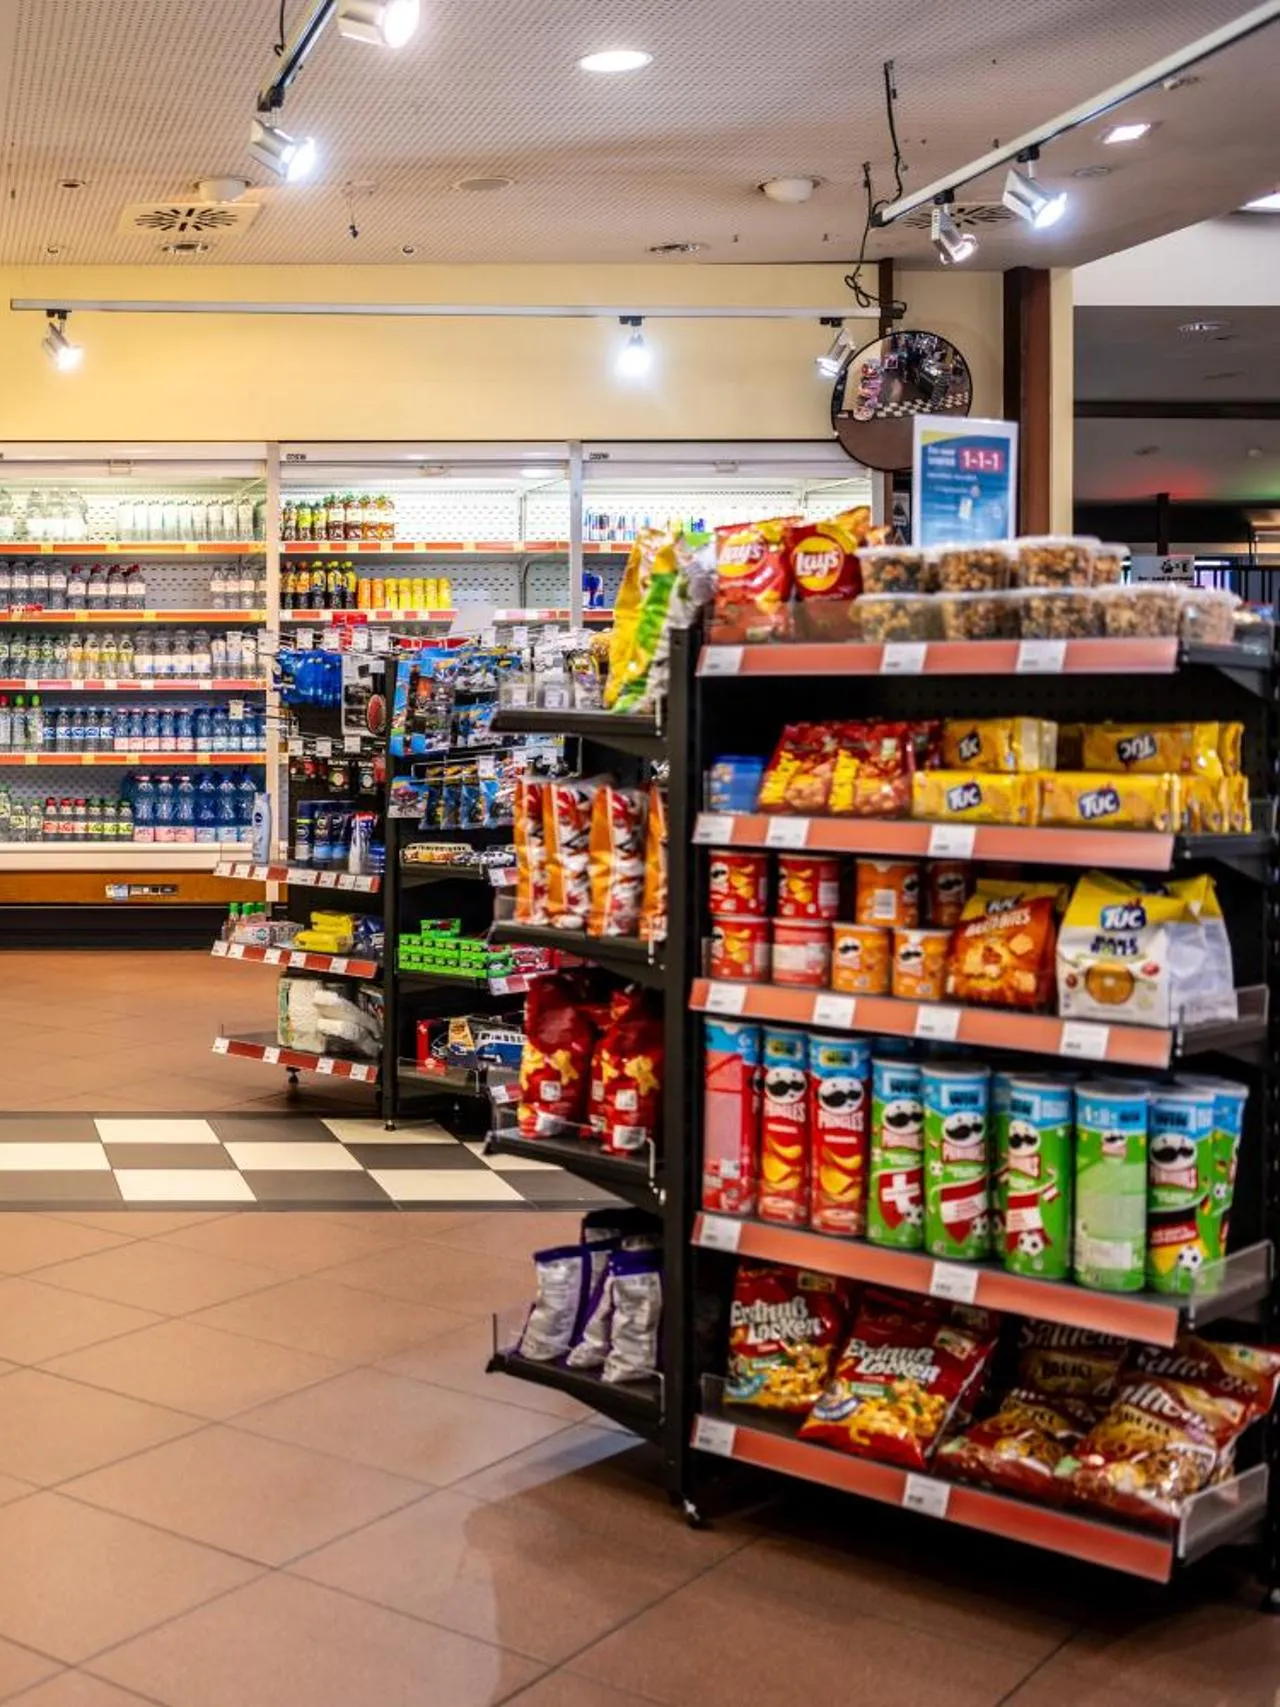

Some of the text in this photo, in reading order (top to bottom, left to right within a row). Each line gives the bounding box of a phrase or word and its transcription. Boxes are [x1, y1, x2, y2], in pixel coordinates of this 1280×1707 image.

[963, 449, 1000, 472] 1-1-1
[948, 785, 981, 811] TUC
[1081, 791, 1120, 818] TUC
[1103, 905, 1145, 930] TUC
